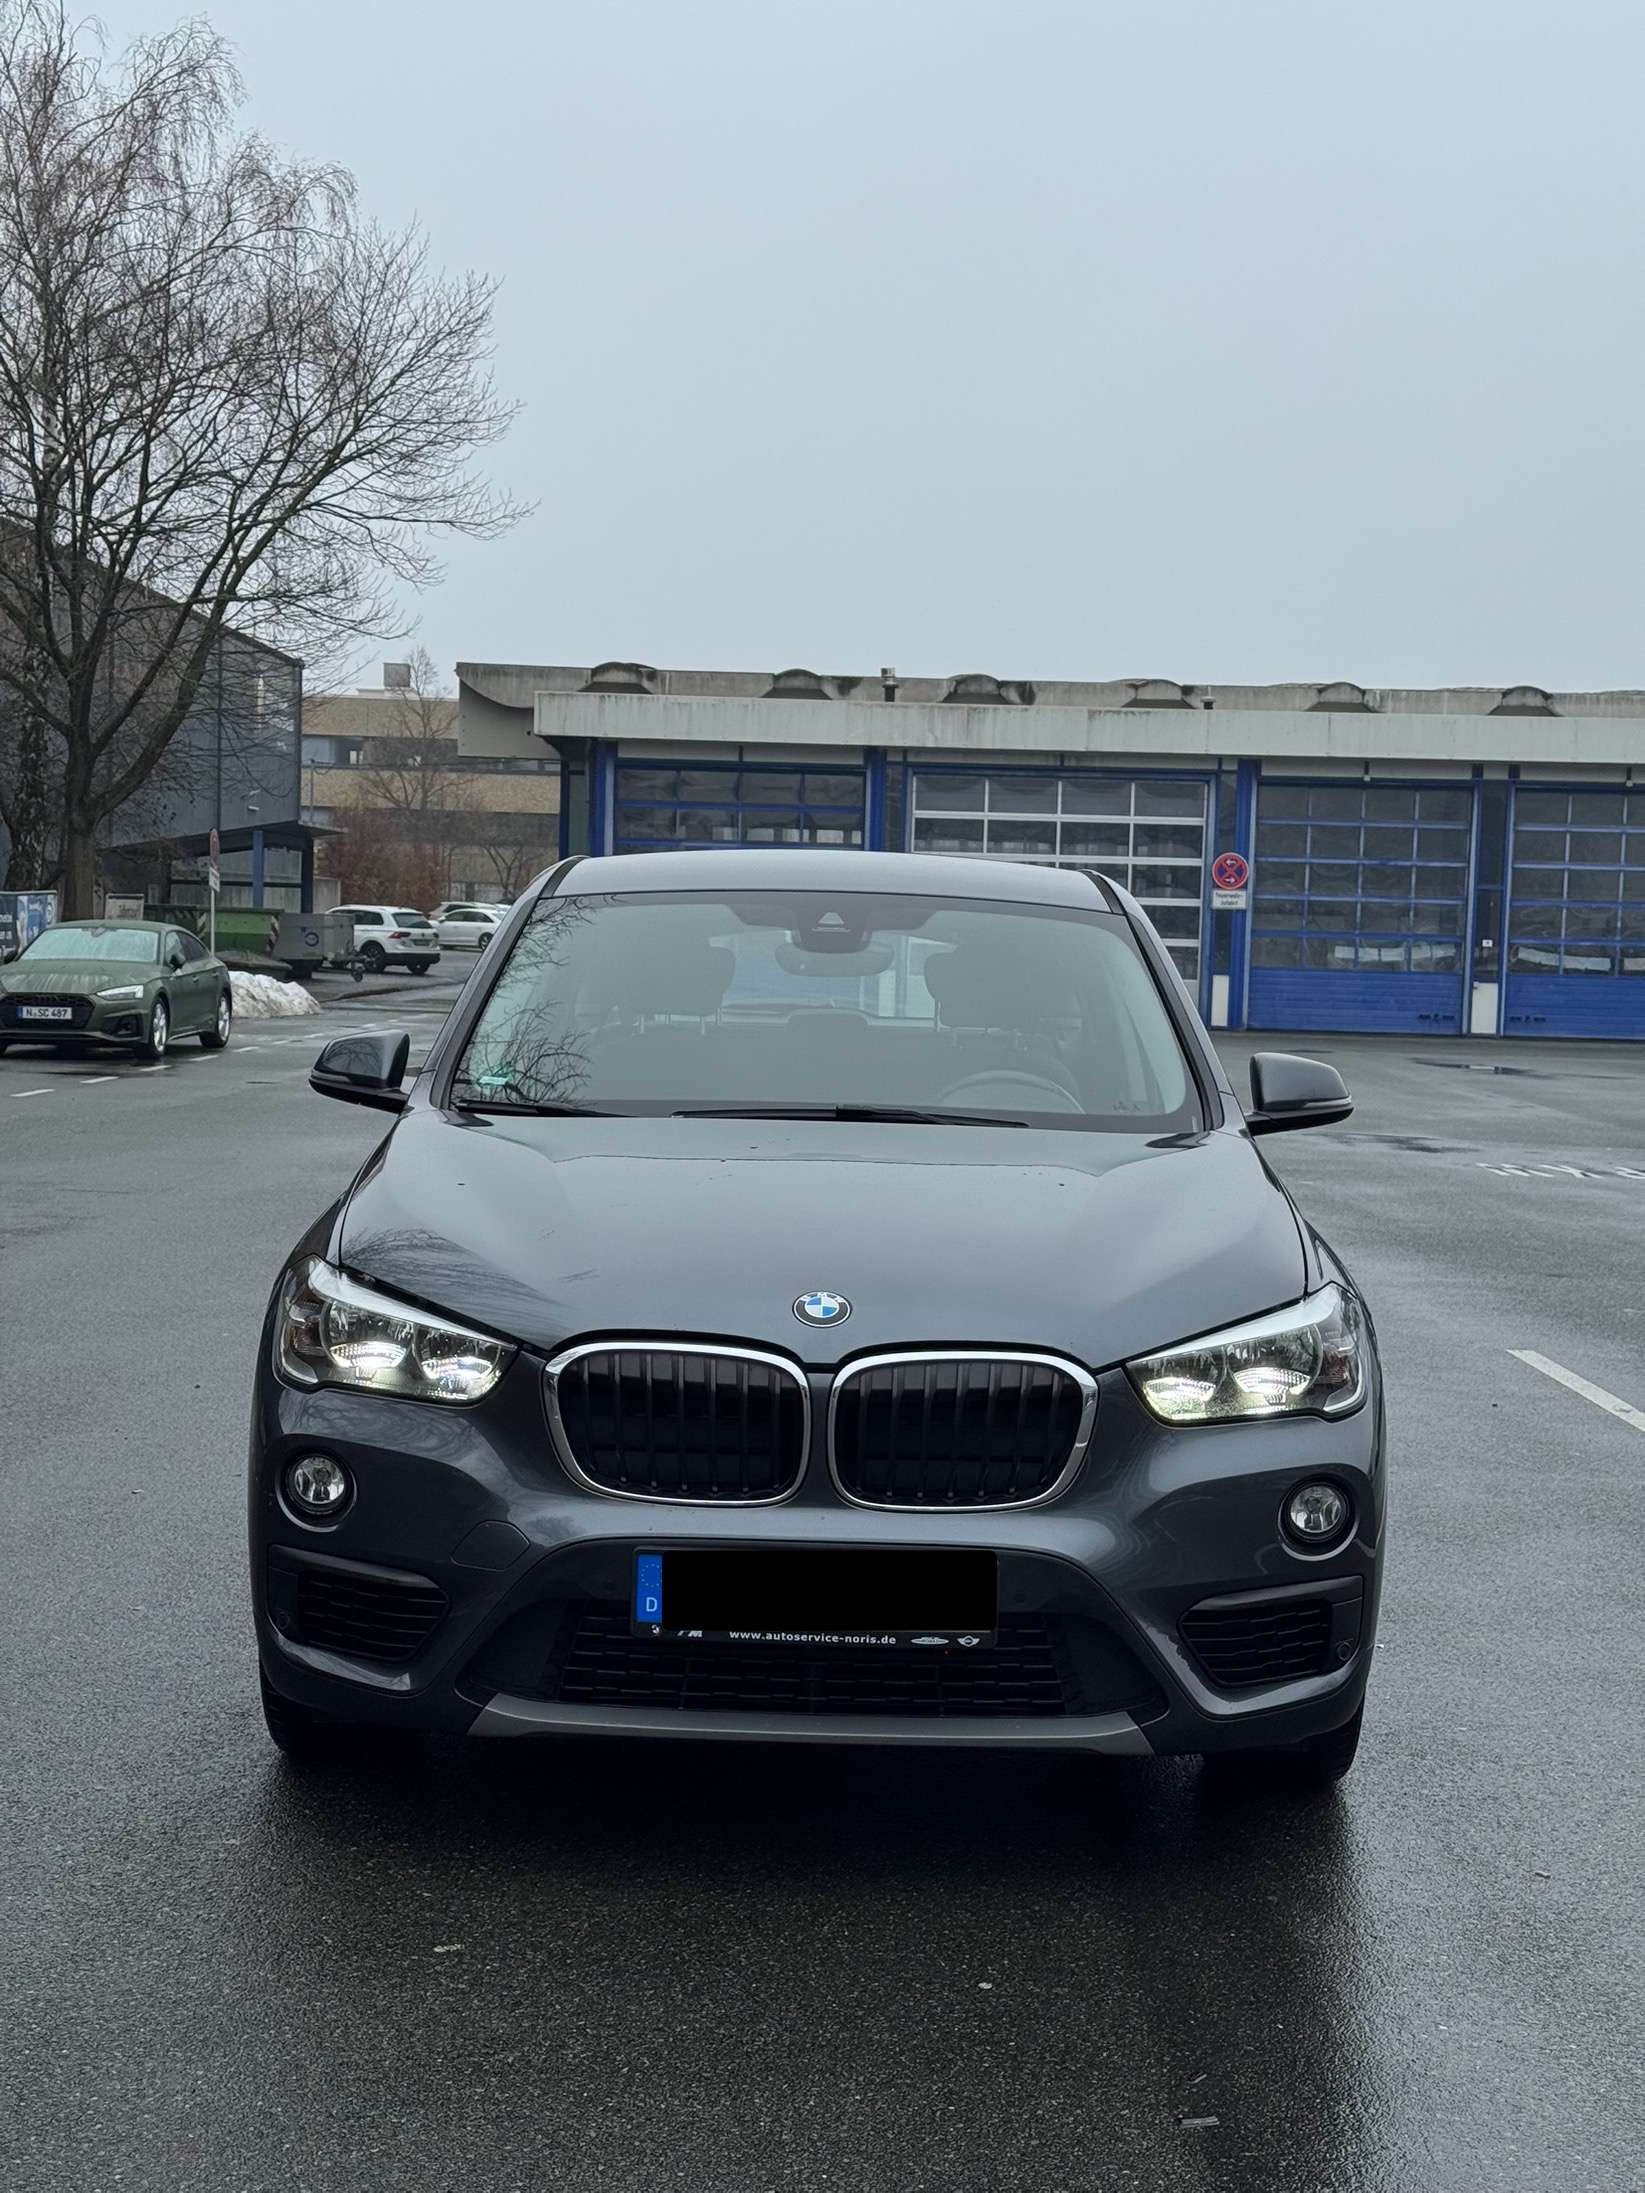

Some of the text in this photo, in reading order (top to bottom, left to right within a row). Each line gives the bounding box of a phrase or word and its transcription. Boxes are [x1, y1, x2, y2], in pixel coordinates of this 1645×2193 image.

[26, 1007, 33, 1017] N
[645, 1596, 658, 1612] D
[729, 1630, 897, 1645] www.autoservice-noris.de
